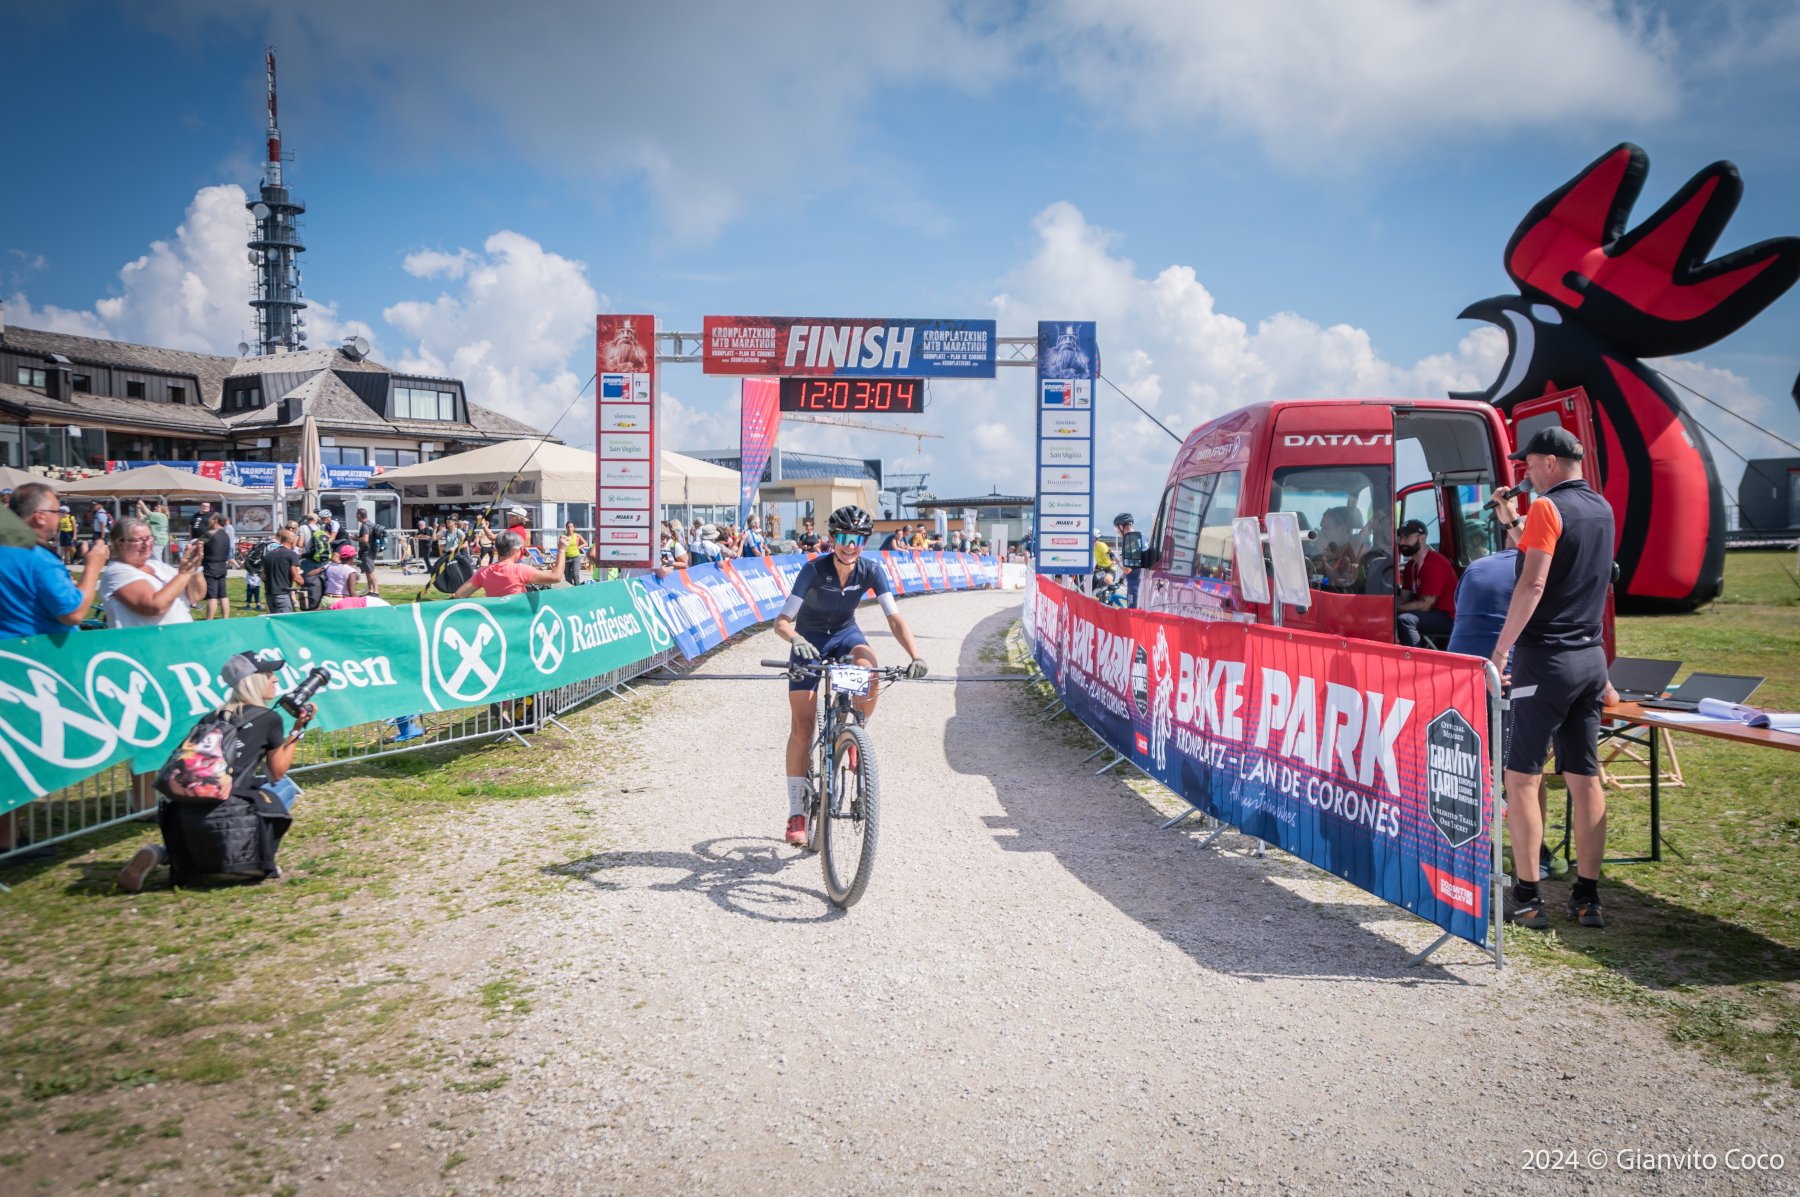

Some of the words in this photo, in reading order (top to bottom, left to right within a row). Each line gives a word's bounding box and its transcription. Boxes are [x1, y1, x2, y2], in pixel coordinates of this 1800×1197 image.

[712, 327, 776, 338] KRONPLATZKING
[712, 338, 729, 348] MTB
[732, 339, 775, 348] MARATHON
[785, 325, 915, 368] FINISH
[923, 330, 987, 342] KRONPLATZKING
[923, 341, 940, 351] MTB
[943, 342, 987, 352] MARATHON
[800, 382, 914, 409] 12:03:04
[567, 606, 642, 653] Raiffeisen
[168, 647, 397, 716] Reisen
[1176, 651, 1246, 741] BIKE
[1254, 666, 1415, 797] PARK
[1430, 743, 1477, 779] GRAVITY
[1177, 727, 1227, 769] KRONPLATZ
[1241, 754, 1277, 788] LAN
[1281, 766, 1301, 798] DE
[1308, 777, 1401, 837] CORONES
[1430, 769, 1458, 802] CARD
[1432, 805, 1459, 820] UNLIMITED
[1441, 878, 1467, 896] DOOMITI
